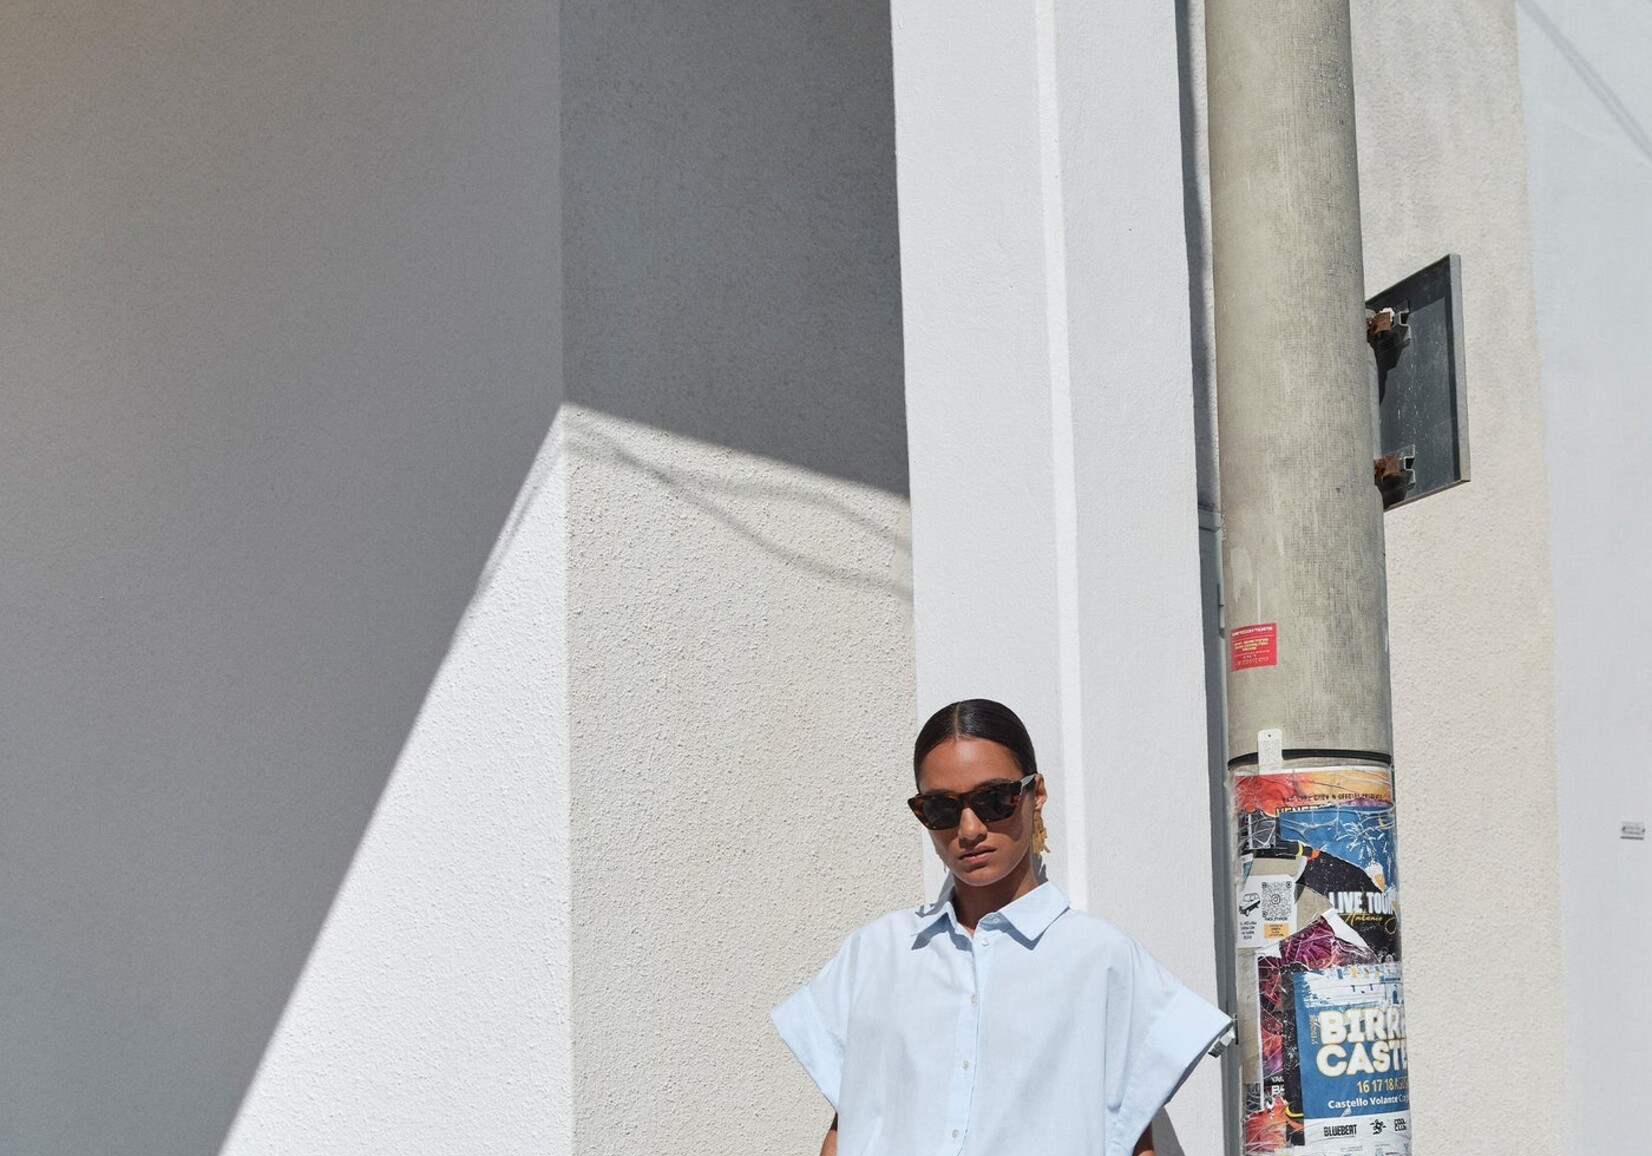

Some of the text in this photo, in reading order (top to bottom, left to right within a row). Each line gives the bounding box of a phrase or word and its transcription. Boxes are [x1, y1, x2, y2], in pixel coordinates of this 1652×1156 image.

[1328, 891, 1363, 914] LIVE
[1356, 1080, 1370, 1094] 16
[1371, 1079, 1382, 1092] 17
[1385, 1077, 1394, 1091] 18
[1327, 1099, 1368, 1109] Castello
